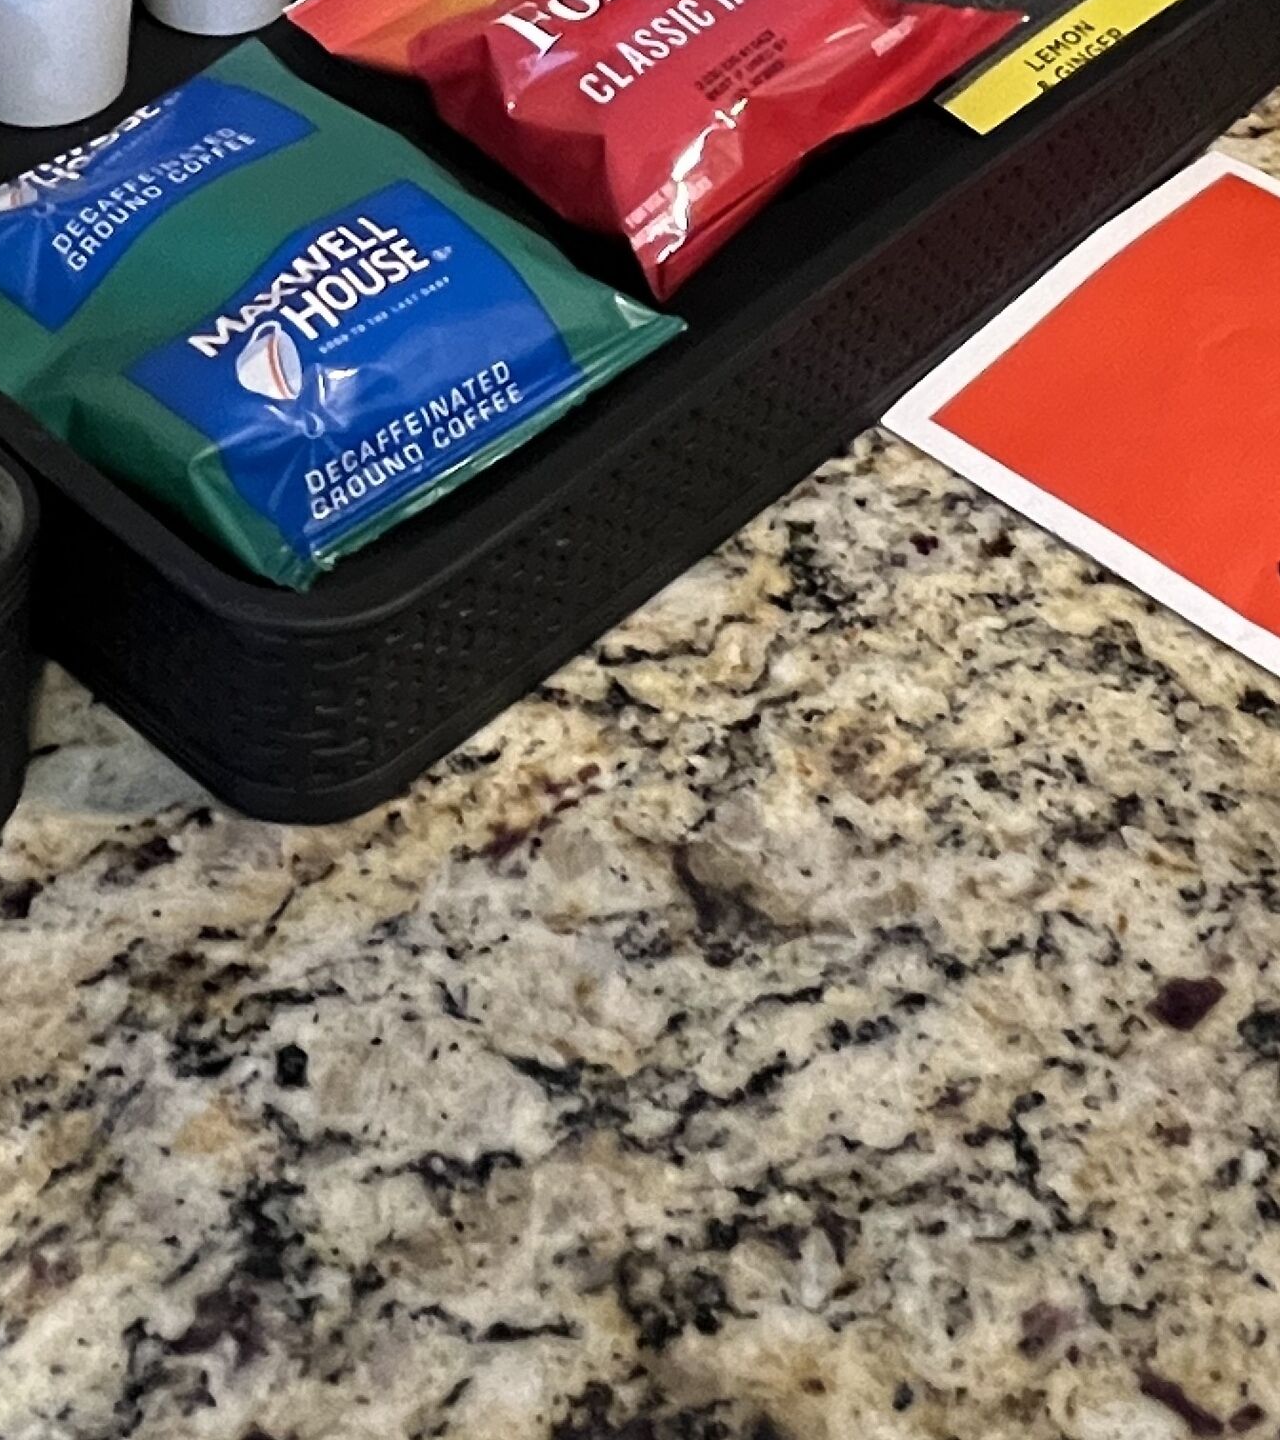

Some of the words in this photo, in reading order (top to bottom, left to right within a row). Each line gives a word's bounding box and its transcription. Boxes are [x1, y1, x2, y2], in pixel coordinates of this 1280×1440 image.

[1023, 19, 1096, 73] LEMON
[1054, 27, 1122, 80] GINGER
[66, 184, 164, 272] GROUND
[167, 133, 257, 184] COFFEE
[187, 216, 399, 358] MAXWELL
[280, 238, 431, 341] HOUSE
[304, 359, 511, 495] DECAFFEINATED
[309, 442, 424, 520] GROUND
[431, 382, 524, 450] COFFEE
